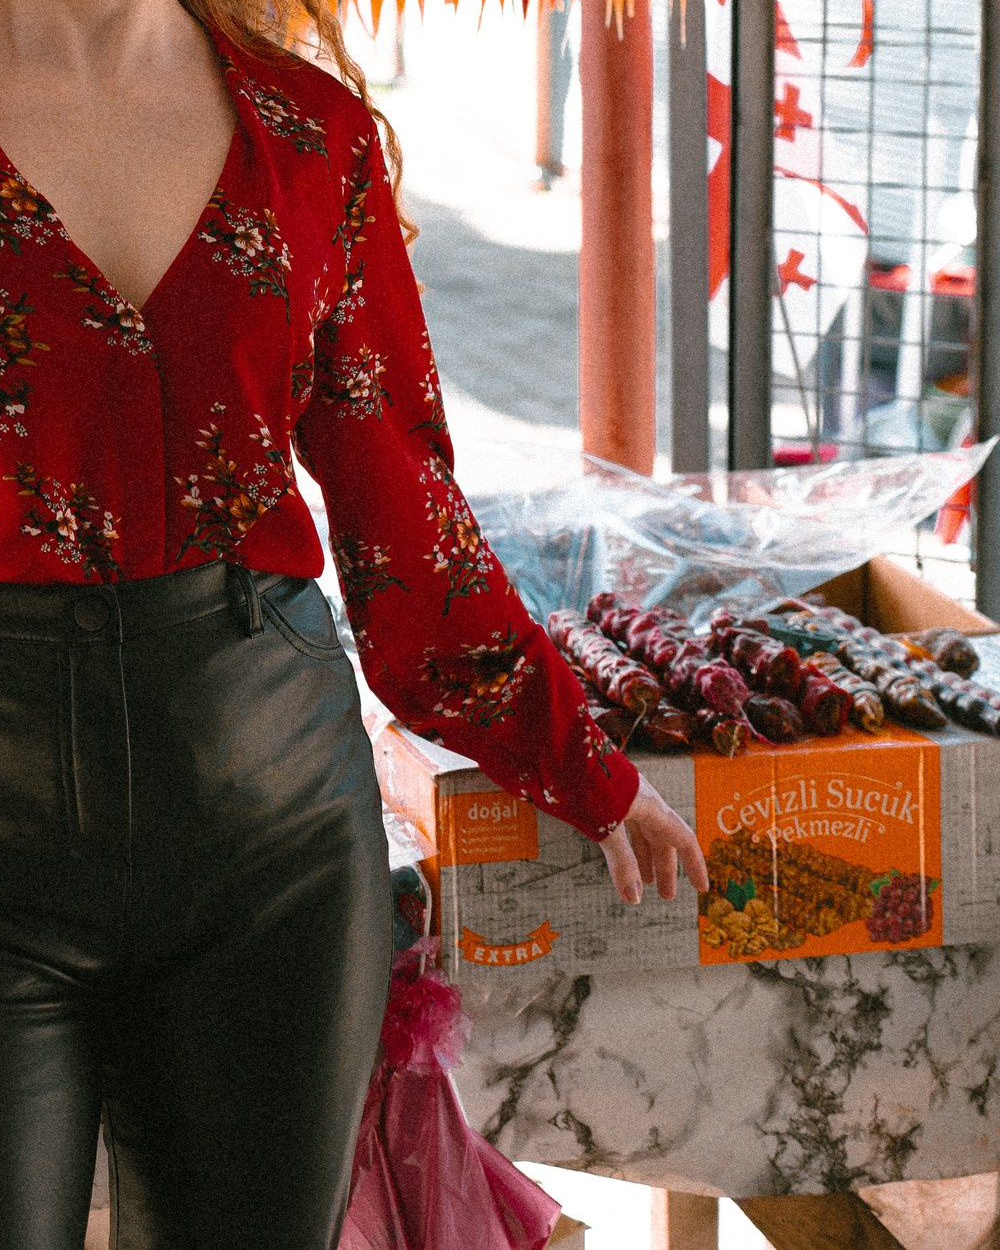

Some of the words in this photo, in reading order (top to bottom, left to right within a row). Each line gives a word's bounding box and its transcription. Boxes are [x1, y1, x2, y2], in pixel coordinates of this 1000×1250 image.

[468, 800, 517, 823] doğal
[717, 779, 818, 835] Cevizli
[826, 779, 919, 824] Sucuk
[474, 943, 542, 963] EXTRA
